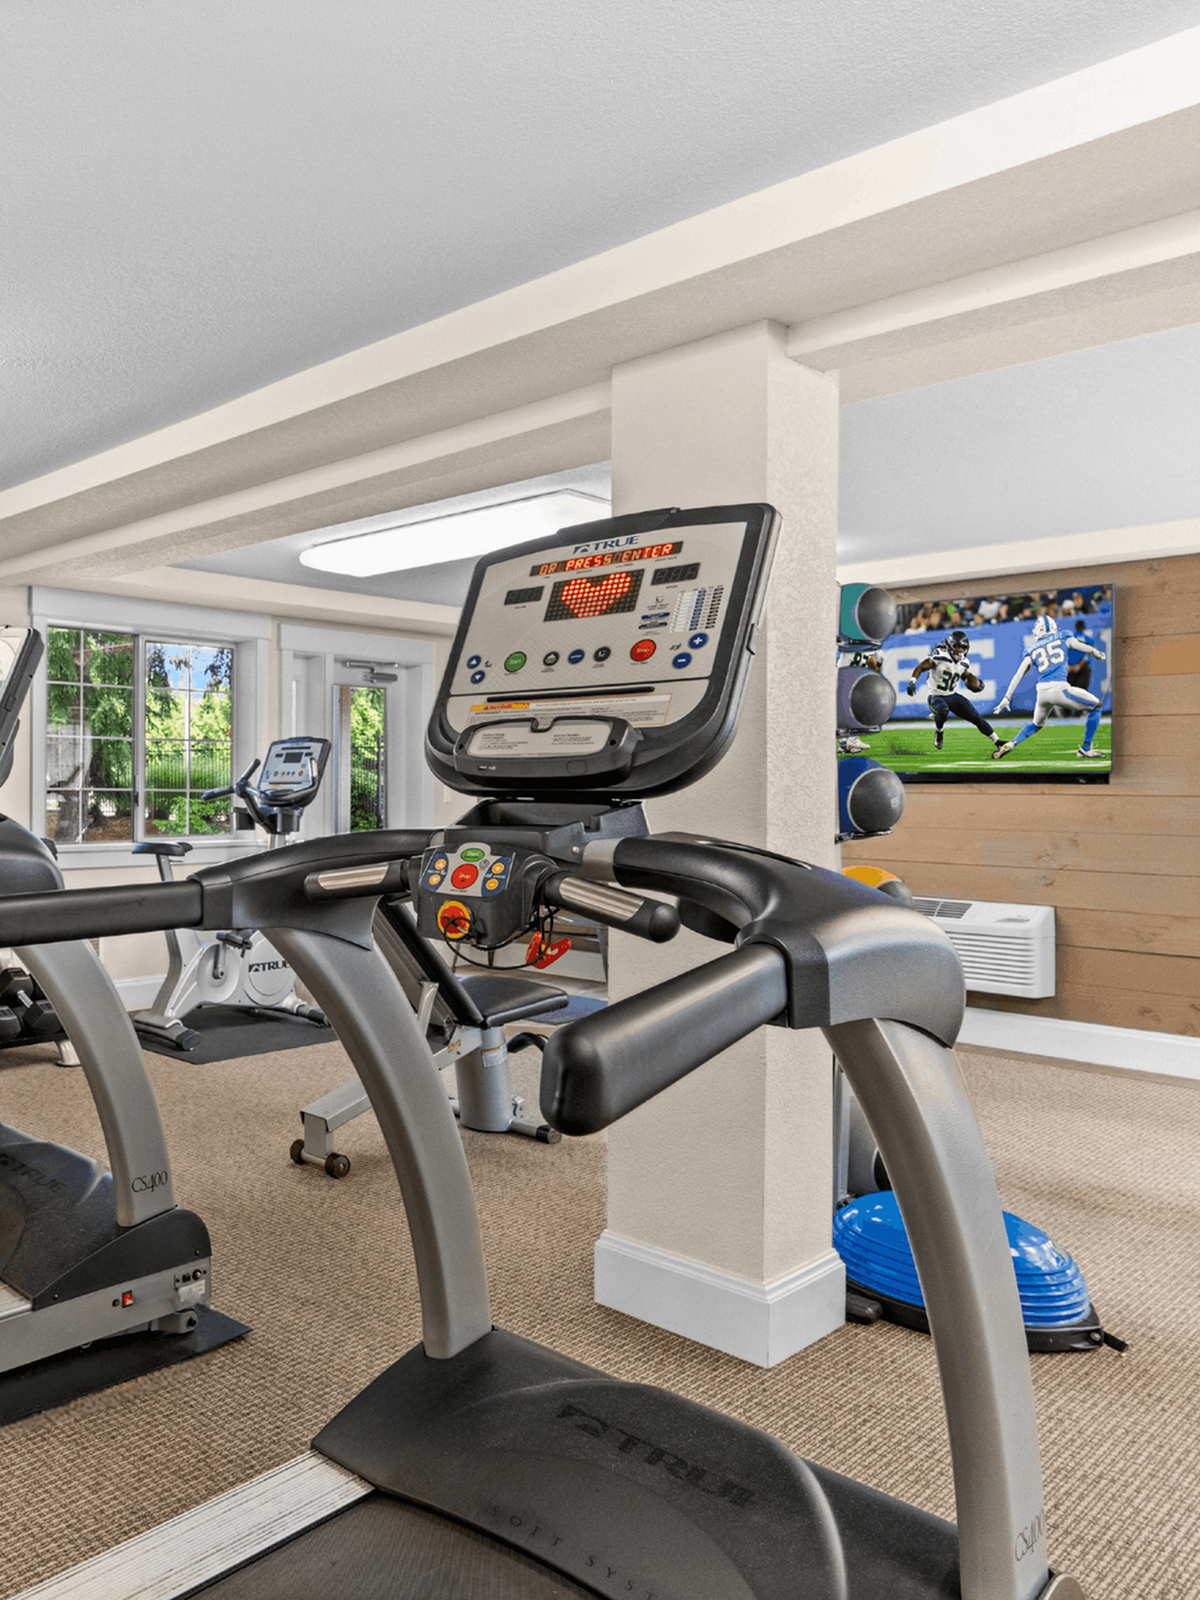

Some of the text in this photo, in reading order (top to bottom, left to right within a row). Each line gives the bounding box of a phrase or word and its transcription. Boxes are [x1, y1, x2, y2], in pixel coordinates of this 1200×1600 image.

[538, 543, 674, 576] OR PRESS ENTER
[592, 535, 640, 551] TRUE
[1031, 639, 1065, 673] 35
[131, 1171, 168, 1193] CS400
[617, 1429, 756, 1507] TRUE
[487, 1504, 564, 1548] SOFT
